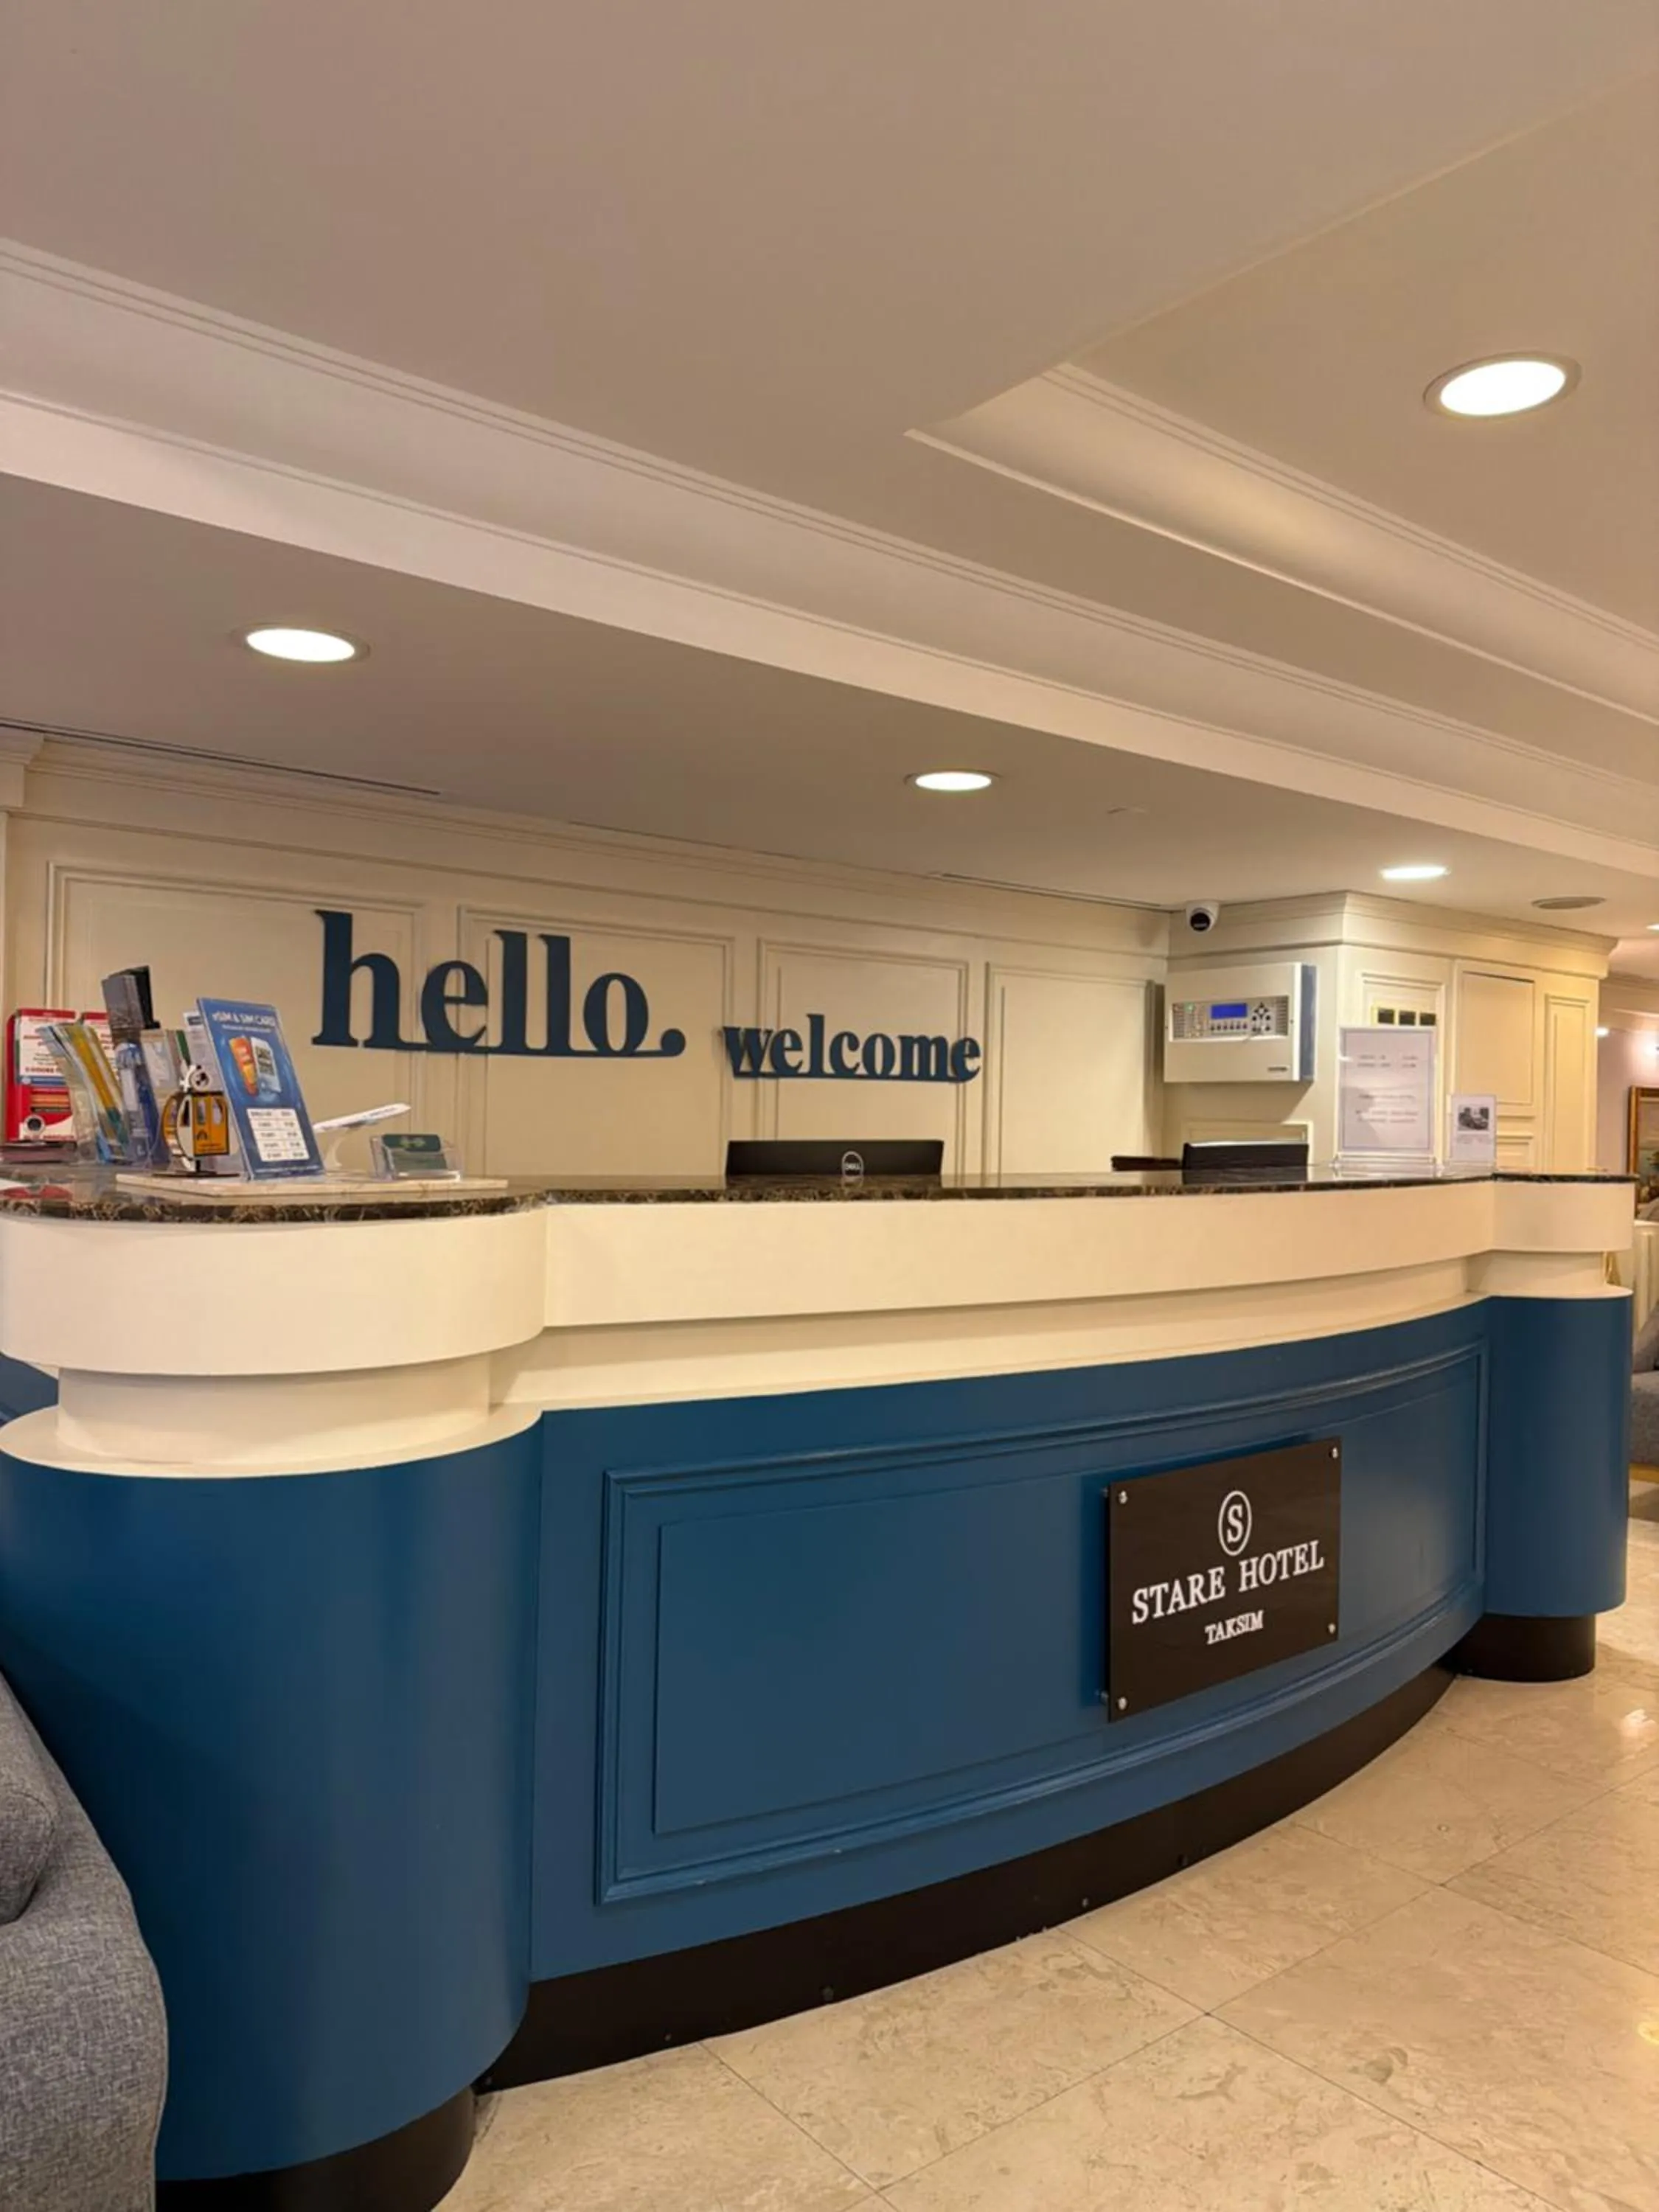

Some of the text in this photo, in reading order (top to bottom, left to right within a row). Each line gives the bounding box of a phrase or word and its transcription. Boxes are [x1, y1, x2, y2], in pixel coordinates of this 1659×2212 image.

[721, 1014, 981, 1083] welcome
[1132, 1540, 1324, 1624] STARE HOTEL
[1204, 1610, 1265, 1645] TAKSIM
